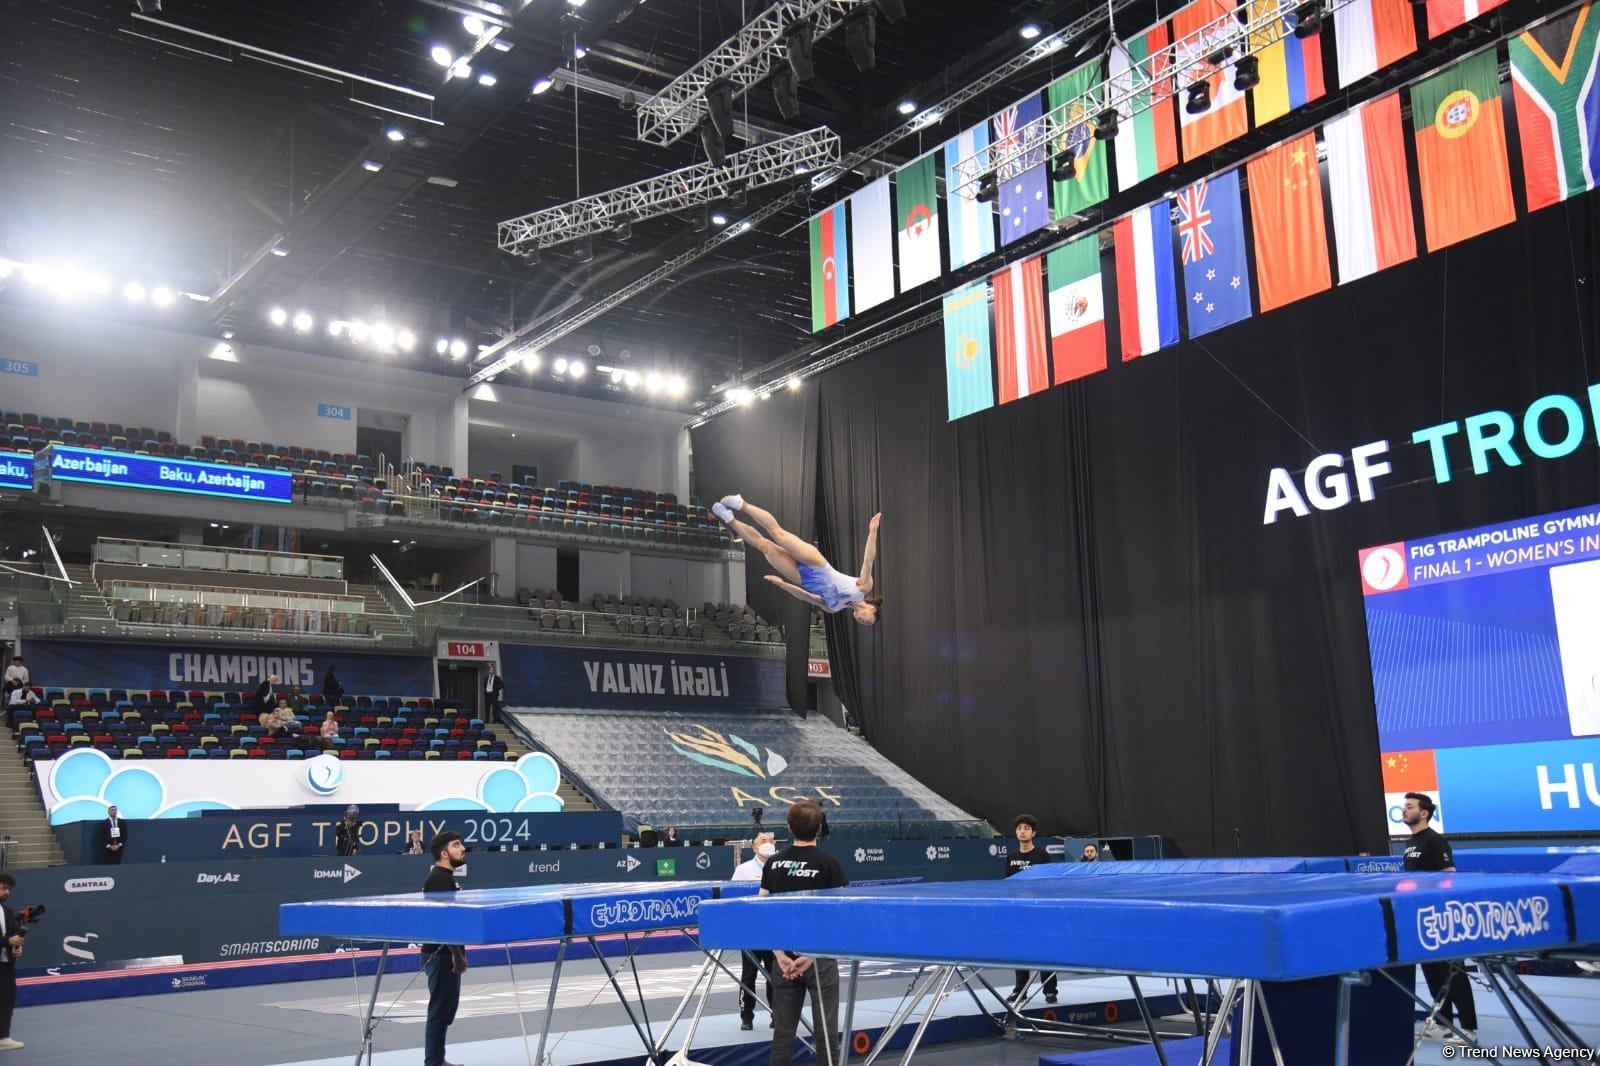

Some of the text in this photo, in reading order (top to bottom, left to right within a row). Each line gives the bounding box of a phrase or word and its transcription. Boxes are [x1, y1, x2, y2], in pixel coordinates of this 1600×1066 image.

[5, 360, 29, 374] 305
[325, 406, 343, 417] 304
[52, 454, 128, 477] Azerbaijan
[160, 465, 265, 492] Baku, Azerbaijan
[1263, 439, 1392, 525] AGF
[1411, 546, 1435, 559] FIG
[1438, 524, 1540, 553] TRAMPOLINE
[1414, 560, 1461, 581] FINAL
[1465, 557, 1471, 572] 1
[1486, 539, 1575, 568] WOMEN'S
[1580, 534, 1600, 553] IN
[456, 644, 476, 655] 104
[169, 653, 314, 686] CHAMPIONS
[808, 663, 824, 672] 103
[583, 661, 665, 695] YALNIZ
[222, 819, 531, 849] AGF TOPHY 2024
[998, 846, 1007, 854] LG
[528, 860, 560, 872] trend
[771, 860, 808, 869] EVENT
[787, 869, 819, 877] HOST
[71, 881, 108, 889] SANTRAL
[197, 872, 240, 884] Day.Az
[591, 896, 701, 928] EUROTRAMP
[1417, 896, 1549, 950] EUROTRAMP
[220, 937, 320, 957] SMARTSCORING
